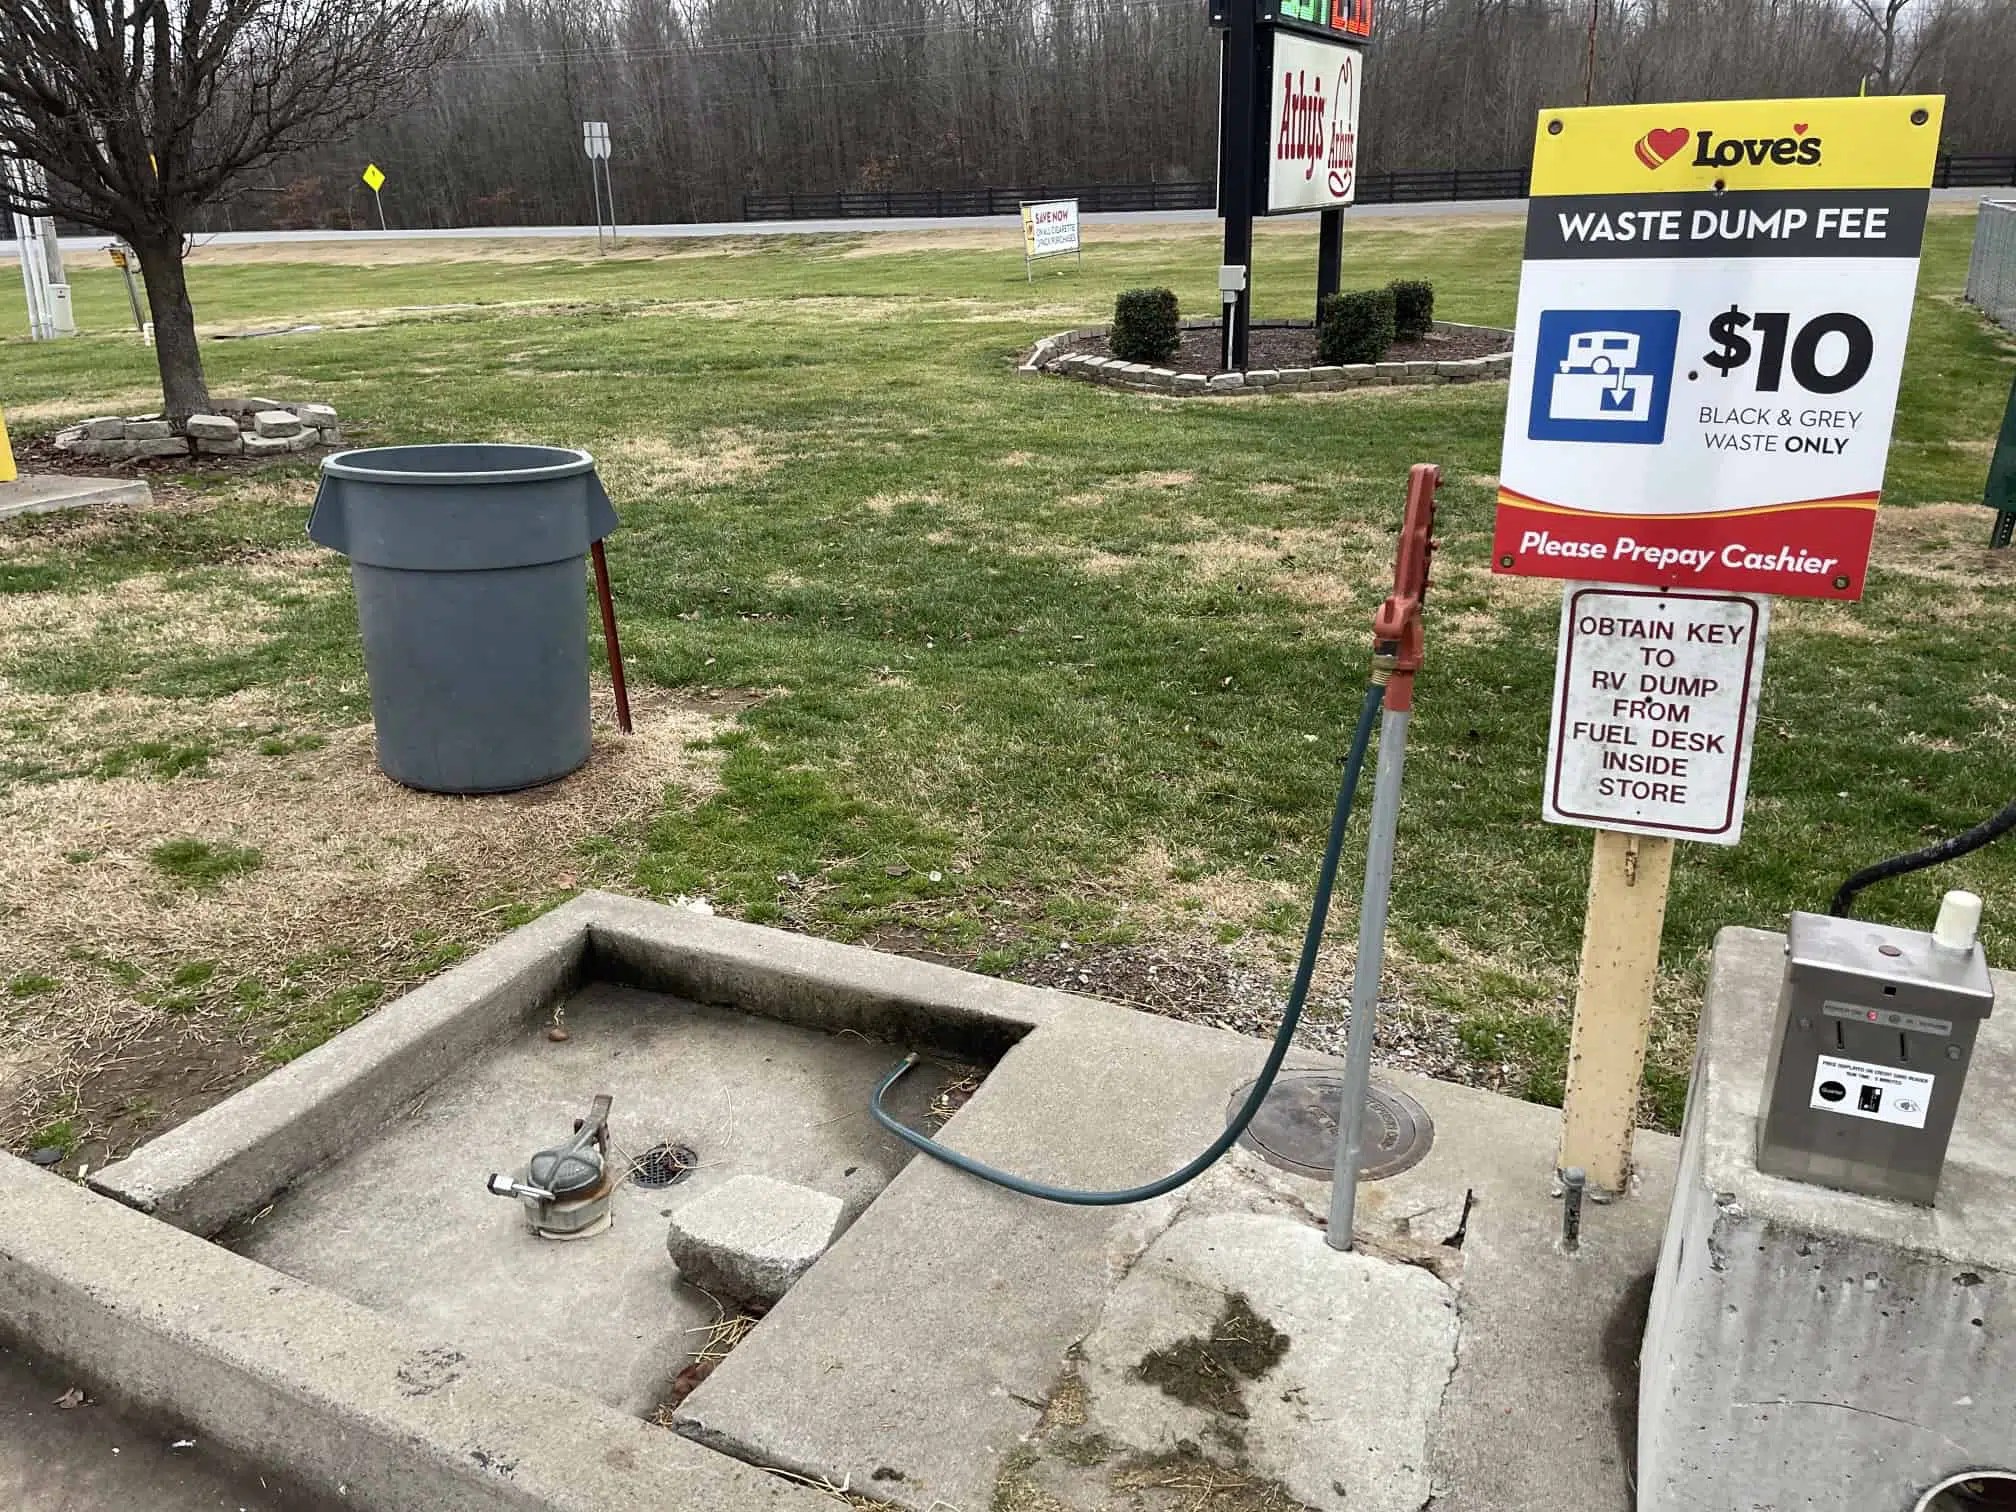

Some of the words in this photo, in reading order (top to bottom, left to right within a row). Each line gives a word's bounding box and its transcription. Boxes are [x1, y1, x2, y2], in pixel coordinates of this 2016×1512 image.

[1277, 70, 1326, 181] Arby's
[1328, 120, 1355, 179] Arby's
[1691, 123, 1822, 168] Love's
[1035, 211, 1051, 225] SAVE
[1052, 210, 1068, 222] NOW
[1558, 210, 1681, 242] WASTE
[1690, 209, 1807, 240] DUMP
[1815, 207, 1890, 239] FEE
[1702, 304, 1874, 395] $10
[1699, 406, 1771, 425] BLACK
[1776, 408, 1792, 427] &
[1799, 409, 1863, 429] GREY
[1704, 432, 1778, 452] WASTE
[1784, 436, 1850, 456] ONLY
[1519, 531, 1608, 560] Please
[1612, 536, 1716, 572] Prepay
[1721, 543, 1838, 575] Cashier
[1579, 615, 1674, 641] OBTAIN
[1687, 622, 1745, 645] KEY
[1640, 646, 1675, 668] TO
[1591, 670, 1627, 691] RV
[1639, 674, 1719, 699] DUMP
[1612, 700, 1690, 723] FROM
[1572, 722, 1638, 746] FUEL
[1651, 729, 1725, 754] DESK
[1602, 752, 1689, 778] INSIDE
[1598, 777, 1688, 804] STORE
